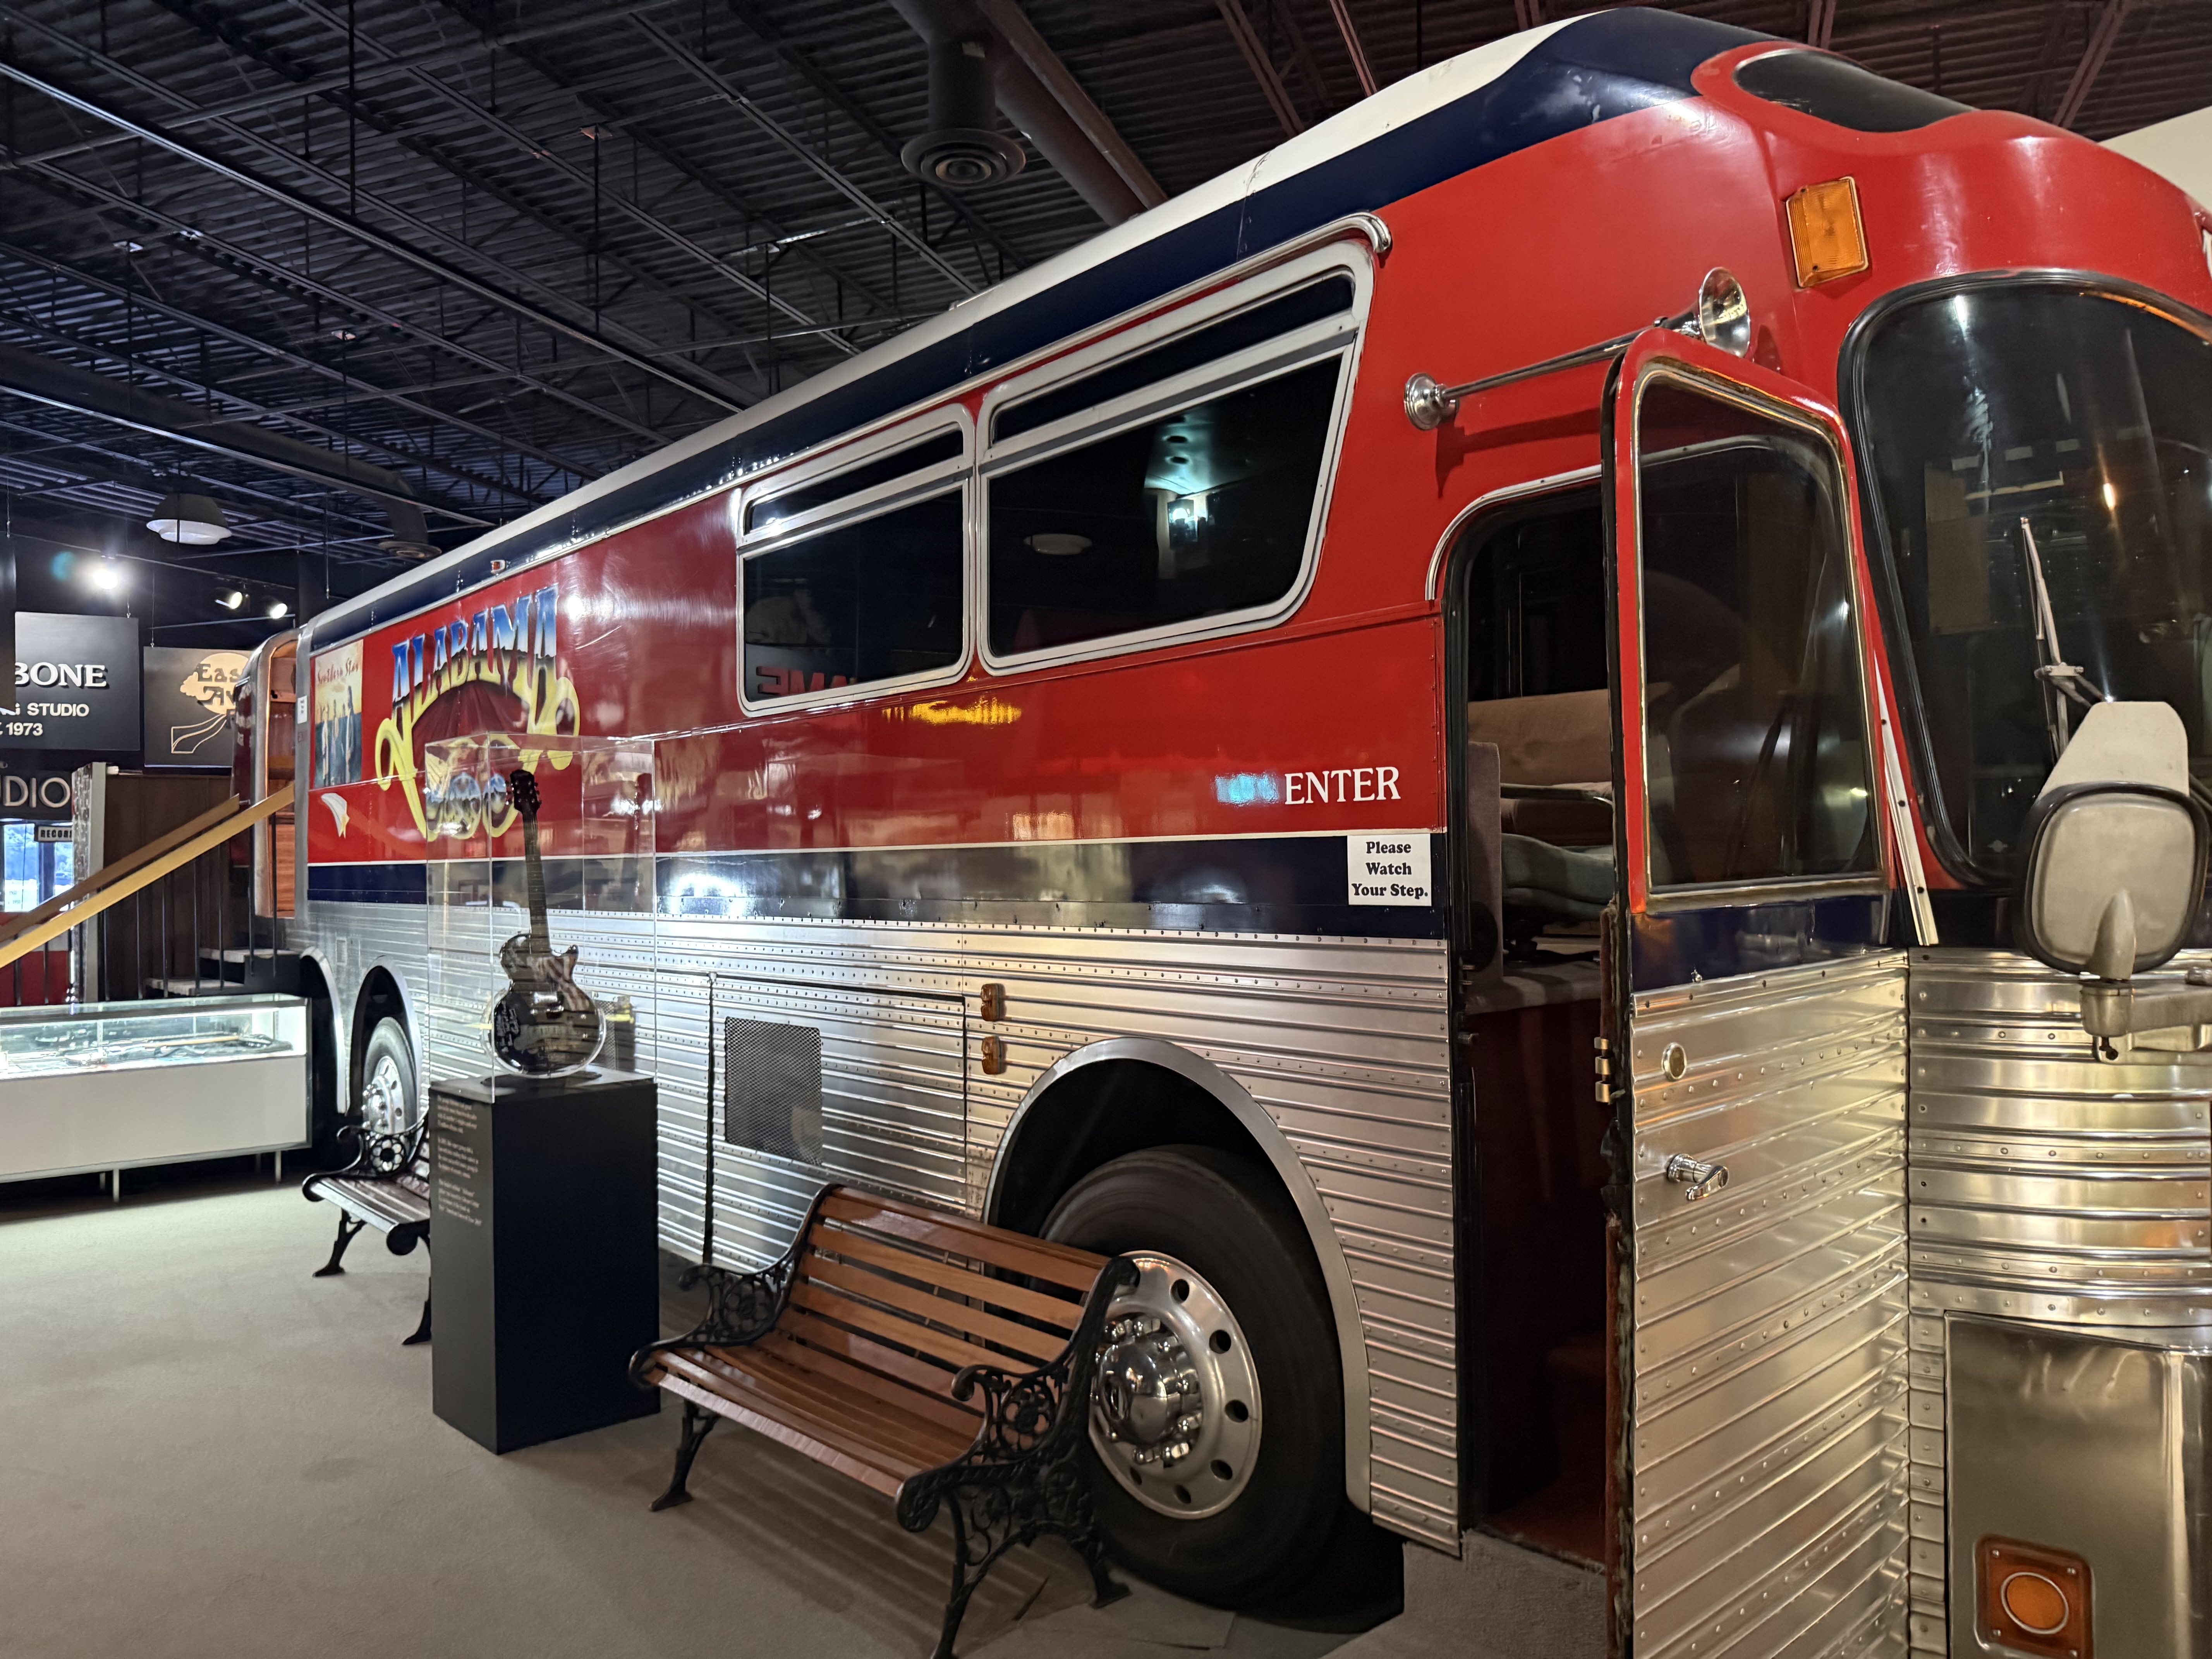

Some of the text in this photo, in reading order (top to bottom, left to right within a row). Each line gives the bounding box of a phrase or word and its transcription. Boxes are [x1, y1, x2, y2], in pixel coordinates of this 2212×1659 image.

[27, 702, 89, 716] STUDIO
[6, 722, 43, 736] 1973
[1285, 766, 1401, 805] ENTER
[1366, 841, 1411, 854] Please
[1365, 862, 1412, 875] Watch
[1352, 883, 1428, 900] Your Step.
